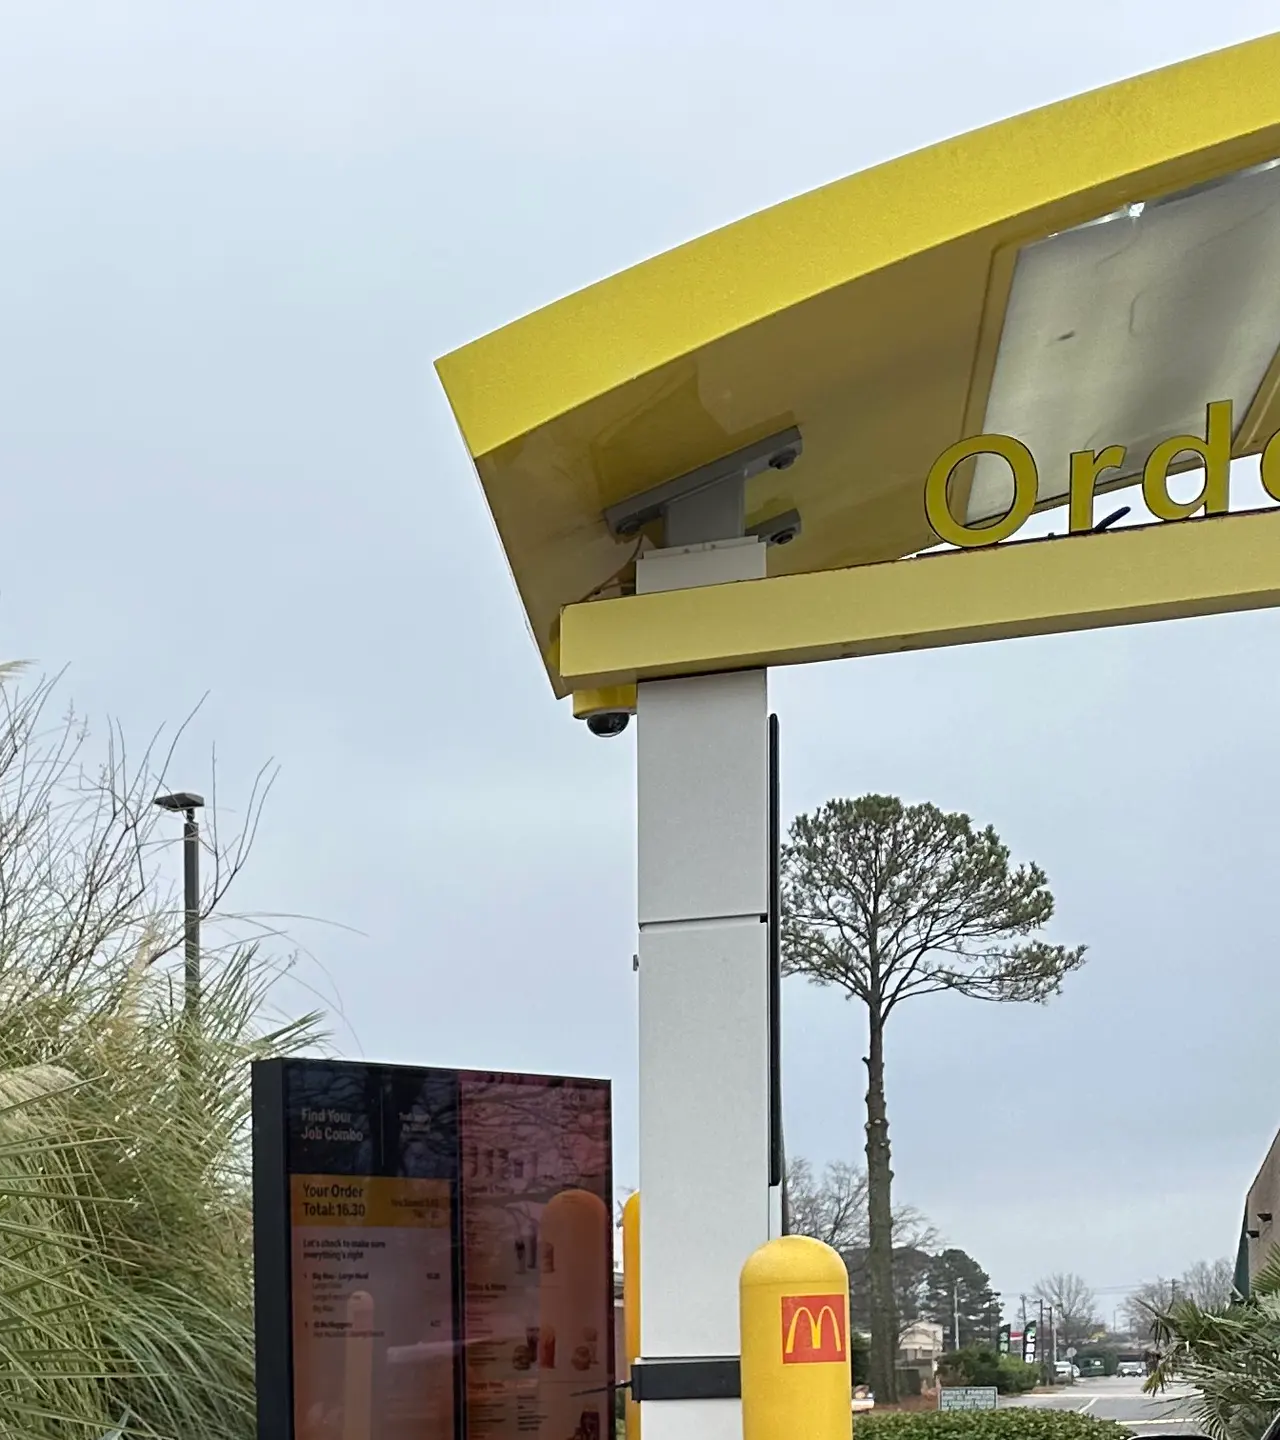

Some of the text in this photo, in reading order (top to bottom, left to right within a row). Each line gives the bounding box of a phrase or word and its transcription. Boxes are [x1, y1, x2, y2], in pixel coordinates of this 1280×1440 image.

[924, 400, 1280, 549] Ord
[301, 1108, 351, 1123] Find Your
[301, 1126, 364, 1141] Job Combo
[302, 1184, 364, 1198] Your Order
[303, 1202, 335, 1216] Total:
